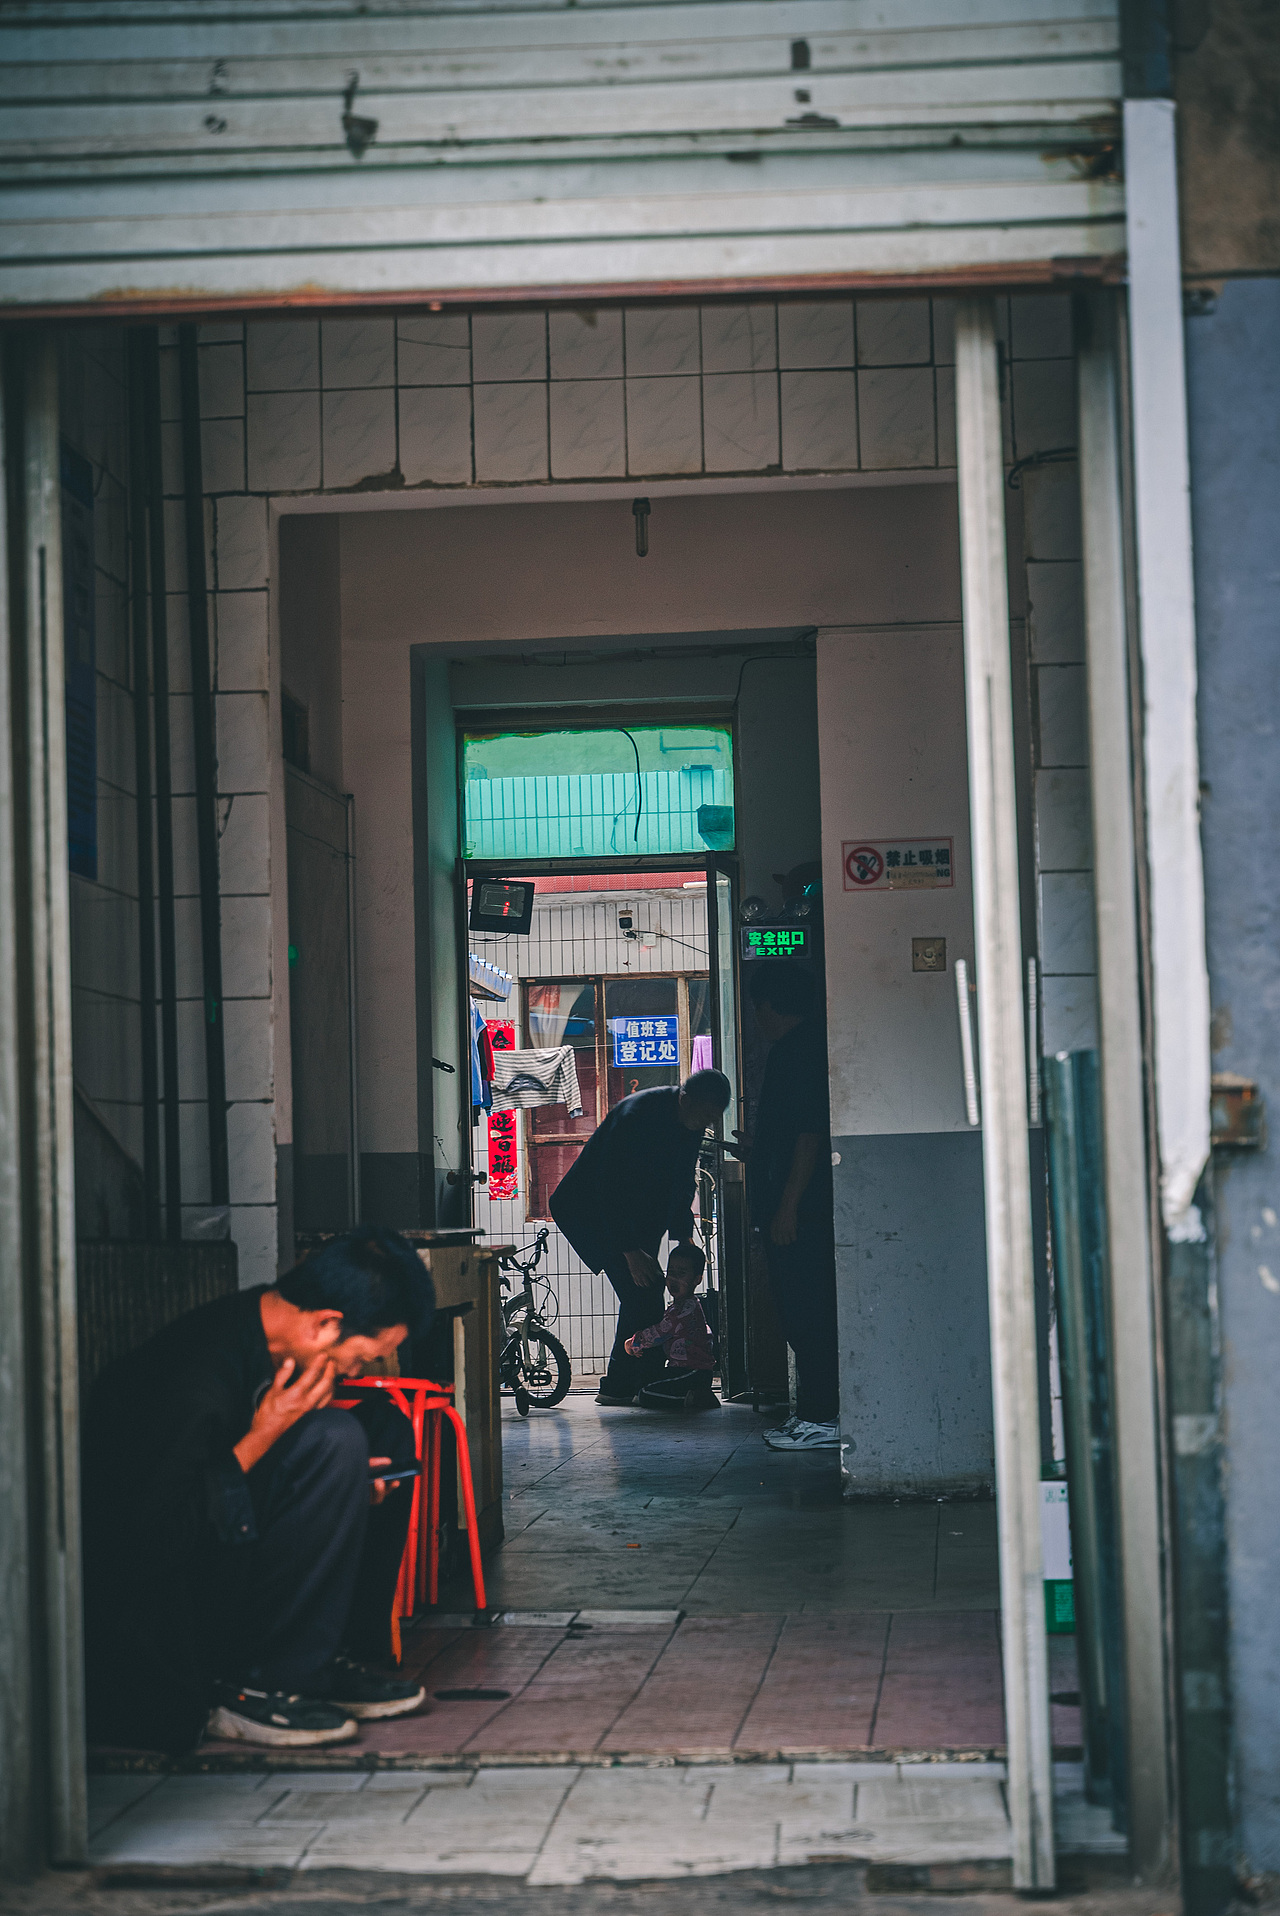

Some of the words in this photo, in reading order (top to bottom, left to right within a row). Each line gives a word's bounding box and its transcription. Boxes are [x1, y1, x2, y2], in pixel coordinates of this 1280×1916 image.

[886, 849, 950, 867] 禁止吸烟
[748, 931, 804, 946] 安全出口
[756, 947, 795, 956] EXIT
[626, 1020, 668, 1038] 值班室
[620, 1040, 676, 1062] 登记处
